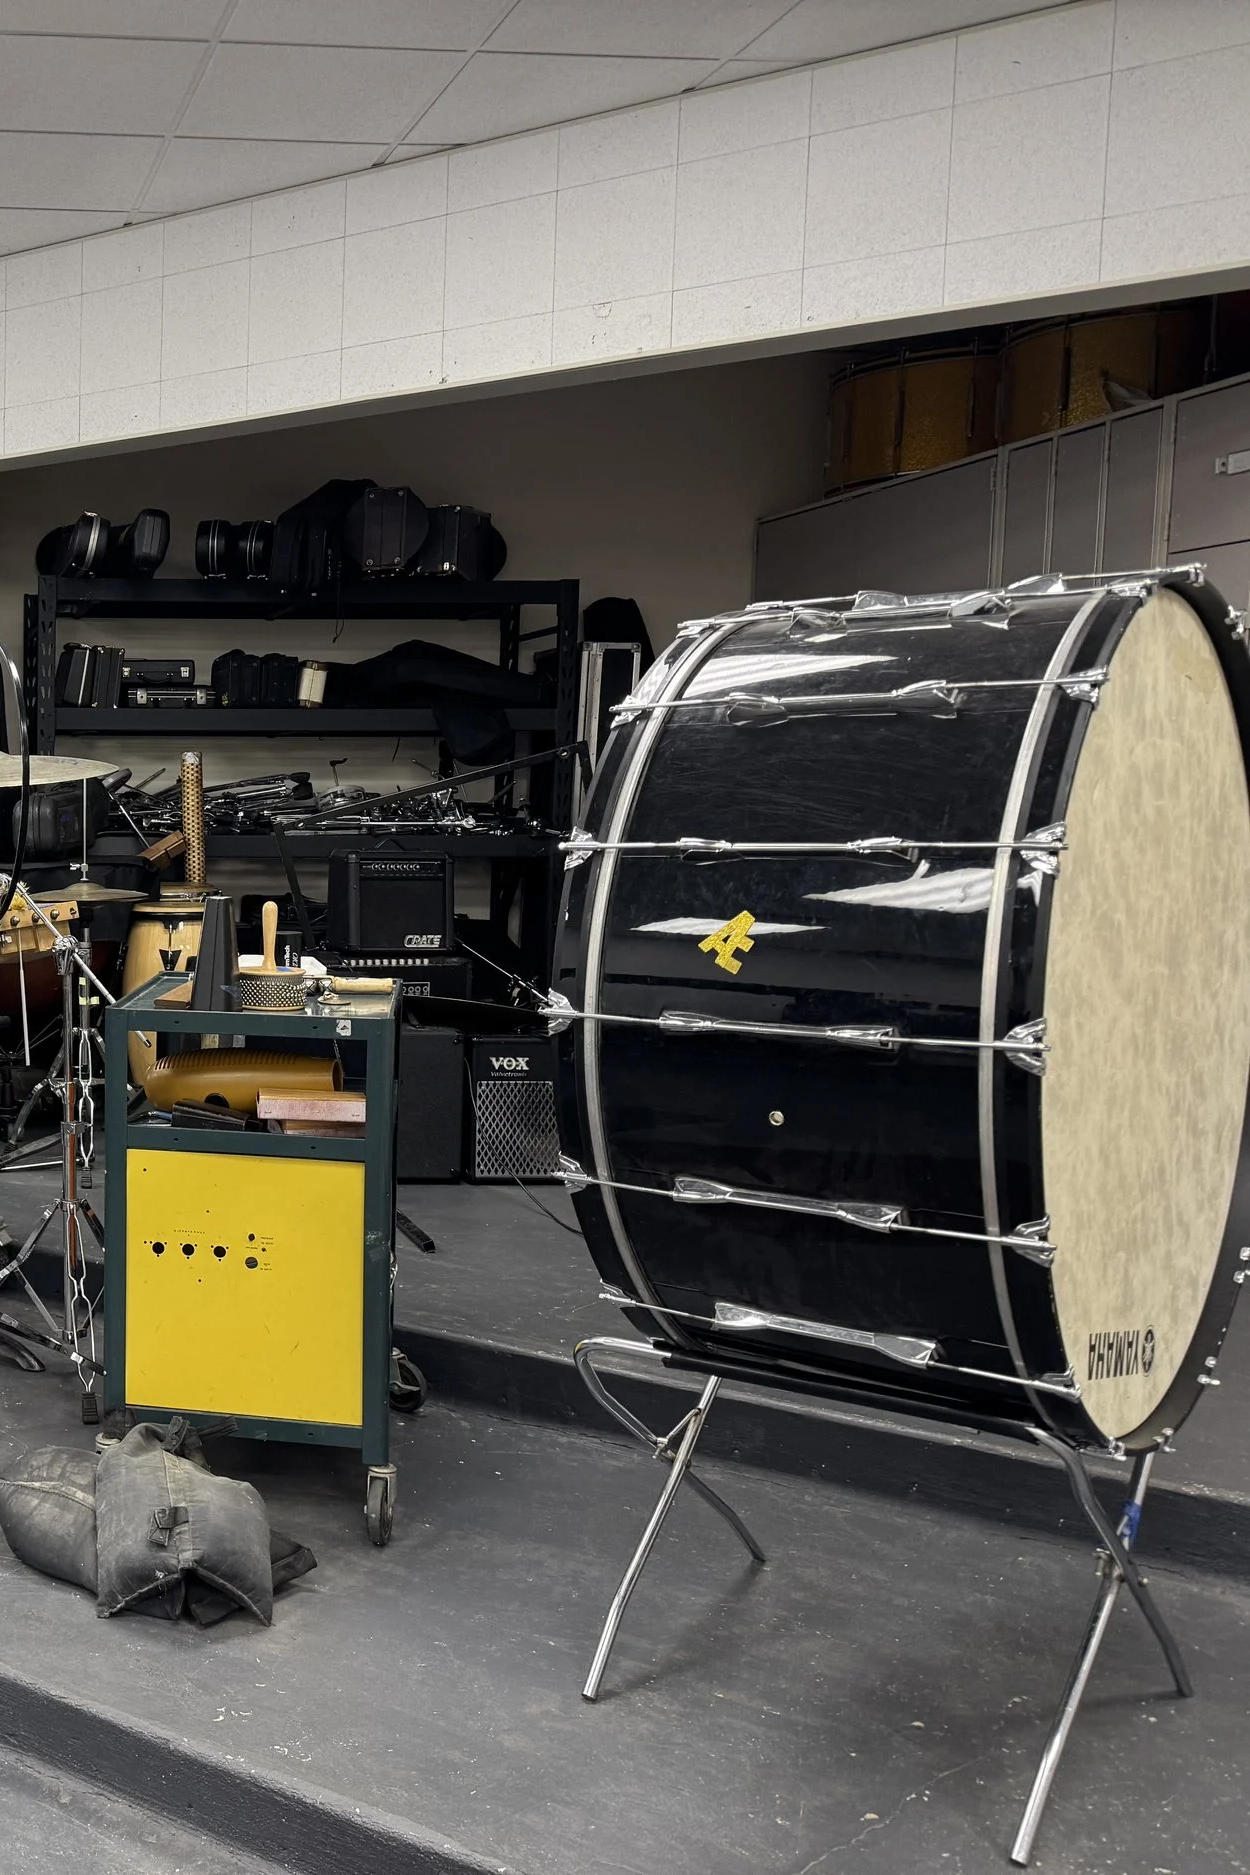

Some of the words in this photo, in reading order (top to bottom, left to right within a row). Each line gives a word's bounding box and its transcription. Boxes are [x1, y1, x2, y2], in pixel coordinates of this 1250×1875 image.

[404, 934, 442, 948] CRATE
[489, 1056, 530, 1070] VOX
[1088, 1330, 1139, 1380] YAMAHA
